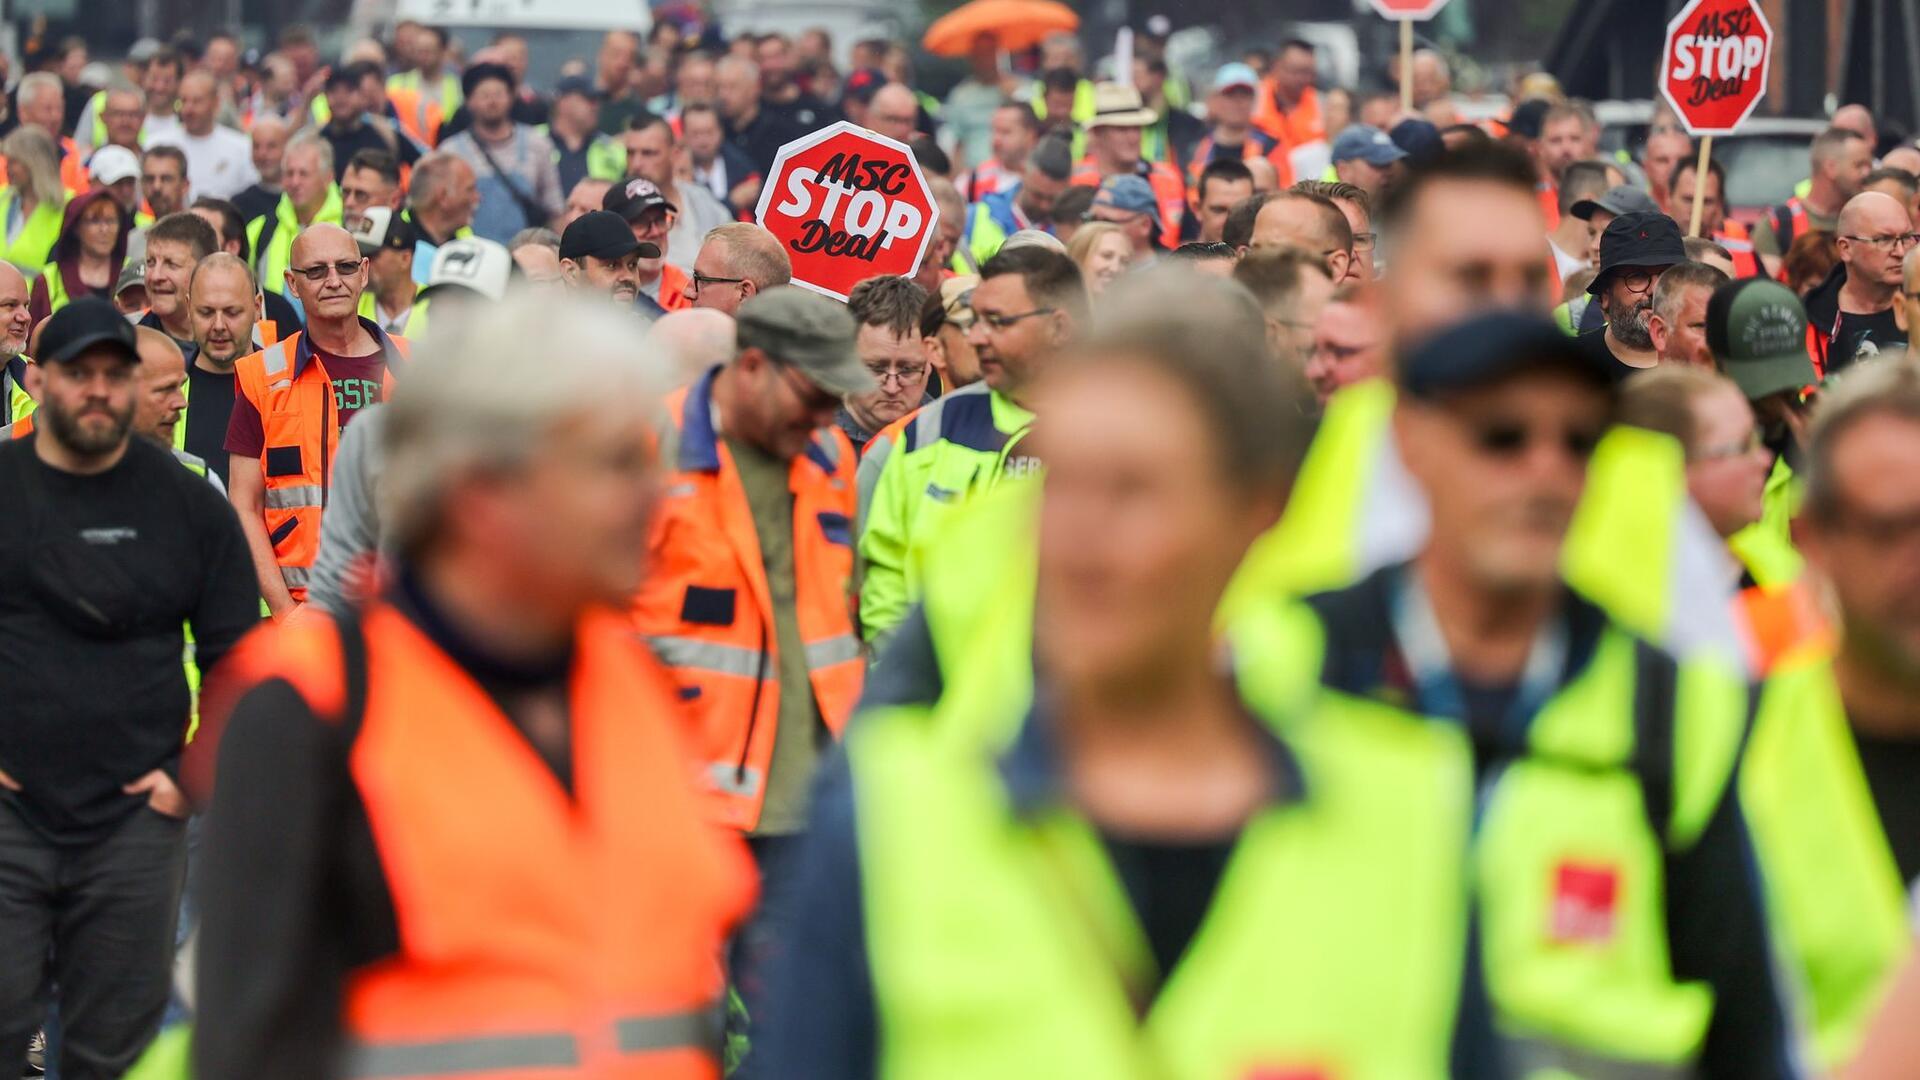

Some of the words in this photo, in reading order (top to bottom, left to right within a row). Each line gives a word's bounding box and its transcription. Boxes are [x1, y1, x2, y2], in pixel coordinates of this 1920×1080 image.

[1694, 6, 1752, 46] MSC
[1672, 34, 1764, 81] STOP
[1687, 66, 1744, 107] Deal
[814, 152, 911, 195] MSC
[776, 166, 922, 250] STOP
[790, 219, 889, 262] Deal
